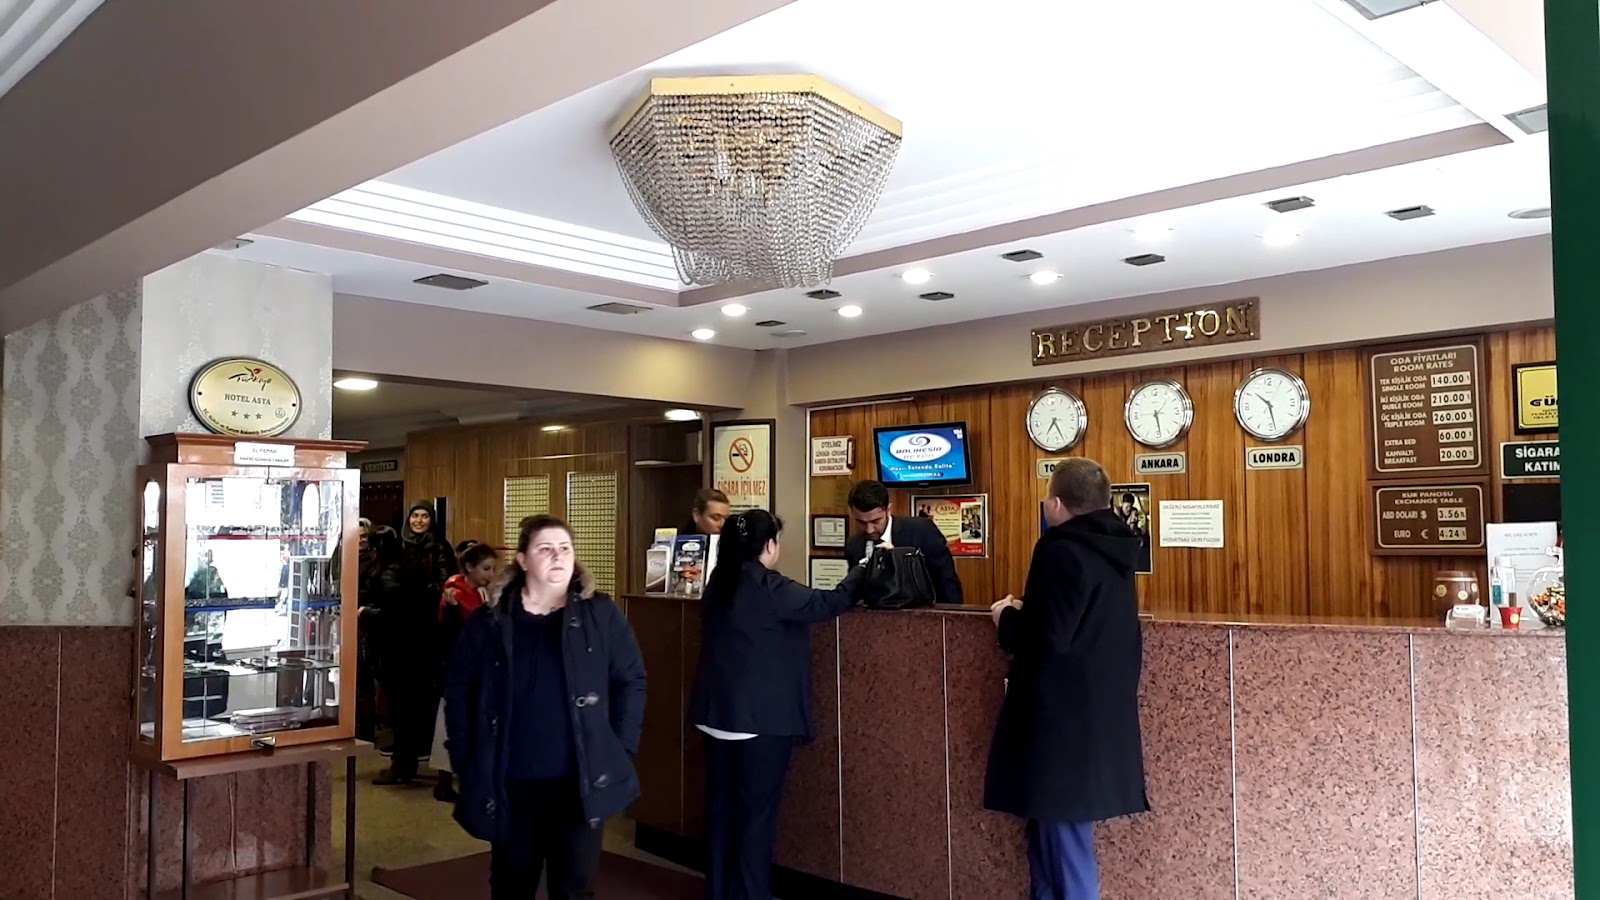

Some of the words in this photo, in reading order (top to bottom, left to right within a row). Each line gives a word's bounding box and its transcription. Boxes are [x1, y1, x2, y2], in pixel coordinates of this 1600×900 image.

[1037, 304, 1250, 359] RECEPTION
[1390, 357, 1410, 365] ODA
[1413, 352, 1456, 362] FİYATLARI
[1394, 364, 1424, 372] ROOM
[1426, 361, 1453, 369] RATES
[1432, 375, 1464, 385] 140.00
[224, 394, 250, 402] HOTEL
[1432, 393, 1464, 403] 210.00
[1434, 411, 1466, 421] 260.00
[1440, 431, 1466, 440] 60.00
[1441, 450, 1467, 458] 20.00
[1515, 446, 1560, 458] SİGARA
[1253, 452, 1295, 463] LONDRA
[1141, 458, 1179, 470] ANKARA
[1396, 511, 1418, 519] DOLARI
